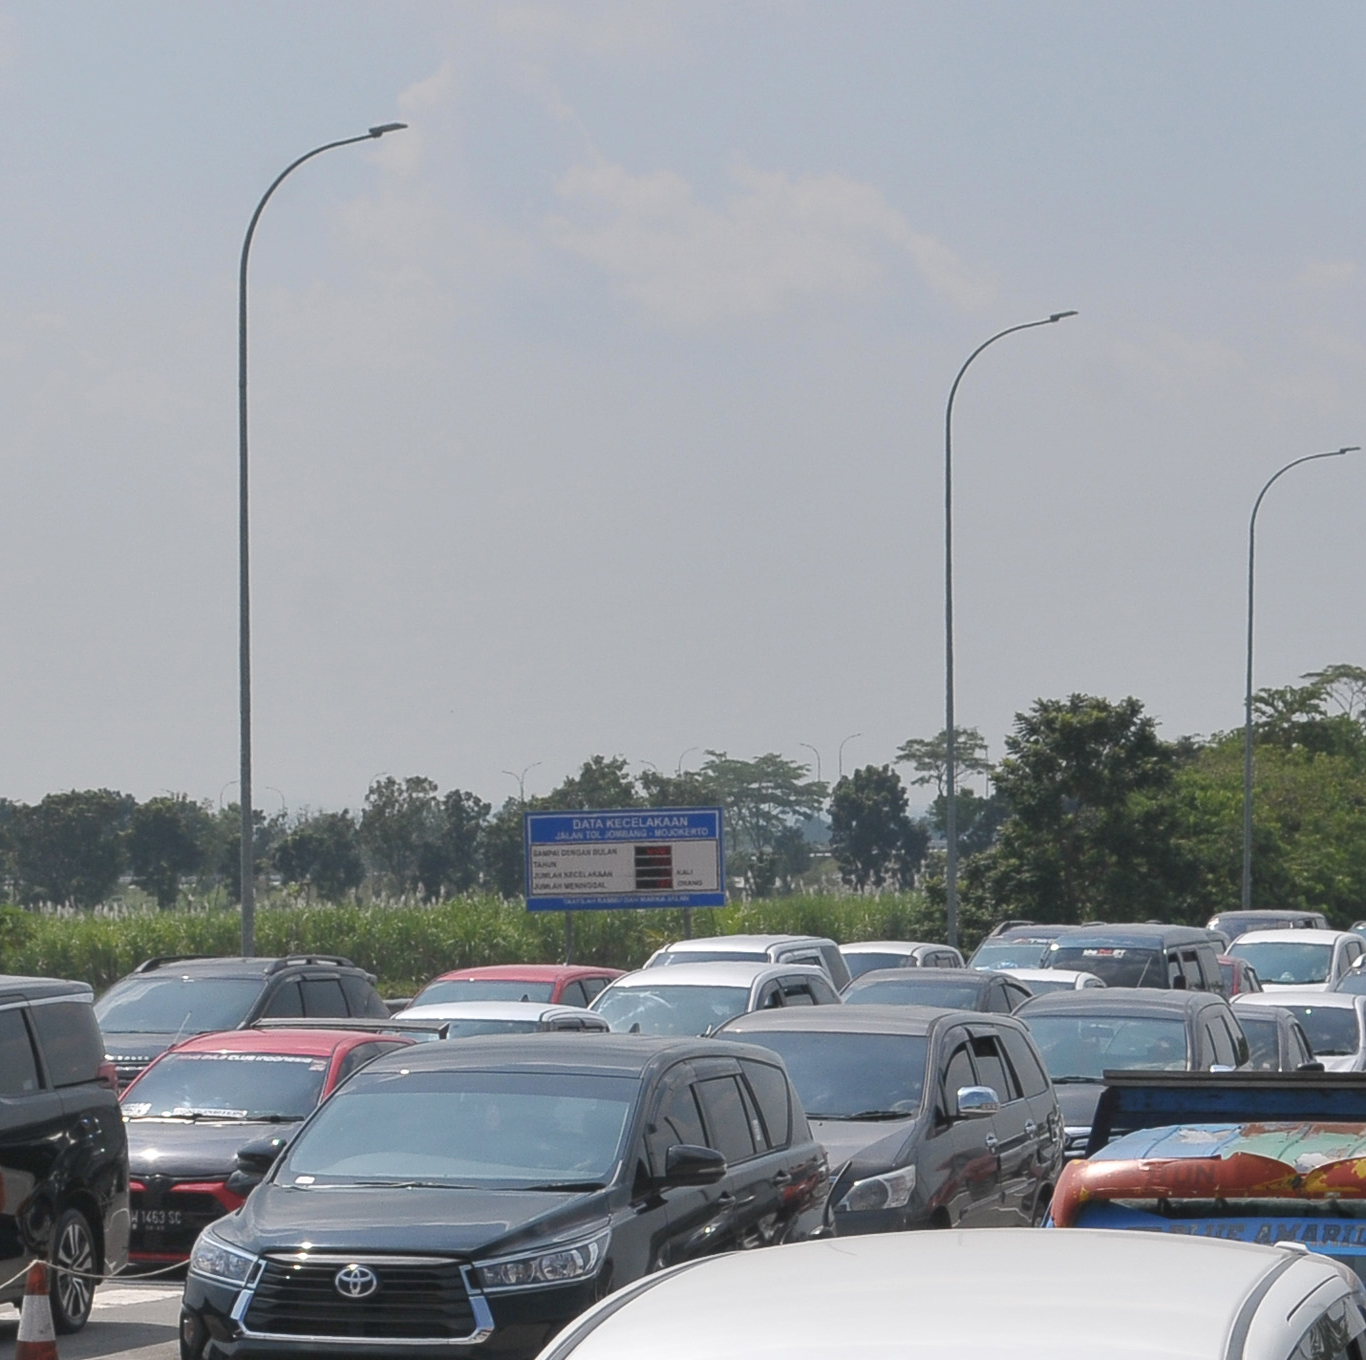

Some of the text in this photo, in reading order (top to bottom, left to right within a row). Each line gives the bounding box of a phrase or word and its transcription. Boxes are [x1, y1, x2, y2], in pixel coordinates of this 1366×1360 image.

[573, 816, 688, 830] DATA KECELAKAAN
[555, 831, 583, 840] JALAN
[586, 830, 601, 839] TOL
[605, 829, 647, 839] JOMBANG
[654, 828, 709, 837] MOJOKERTO
[141, 1211, 165, 1224] 1463
[168, 1211, 182, 1225] SC
